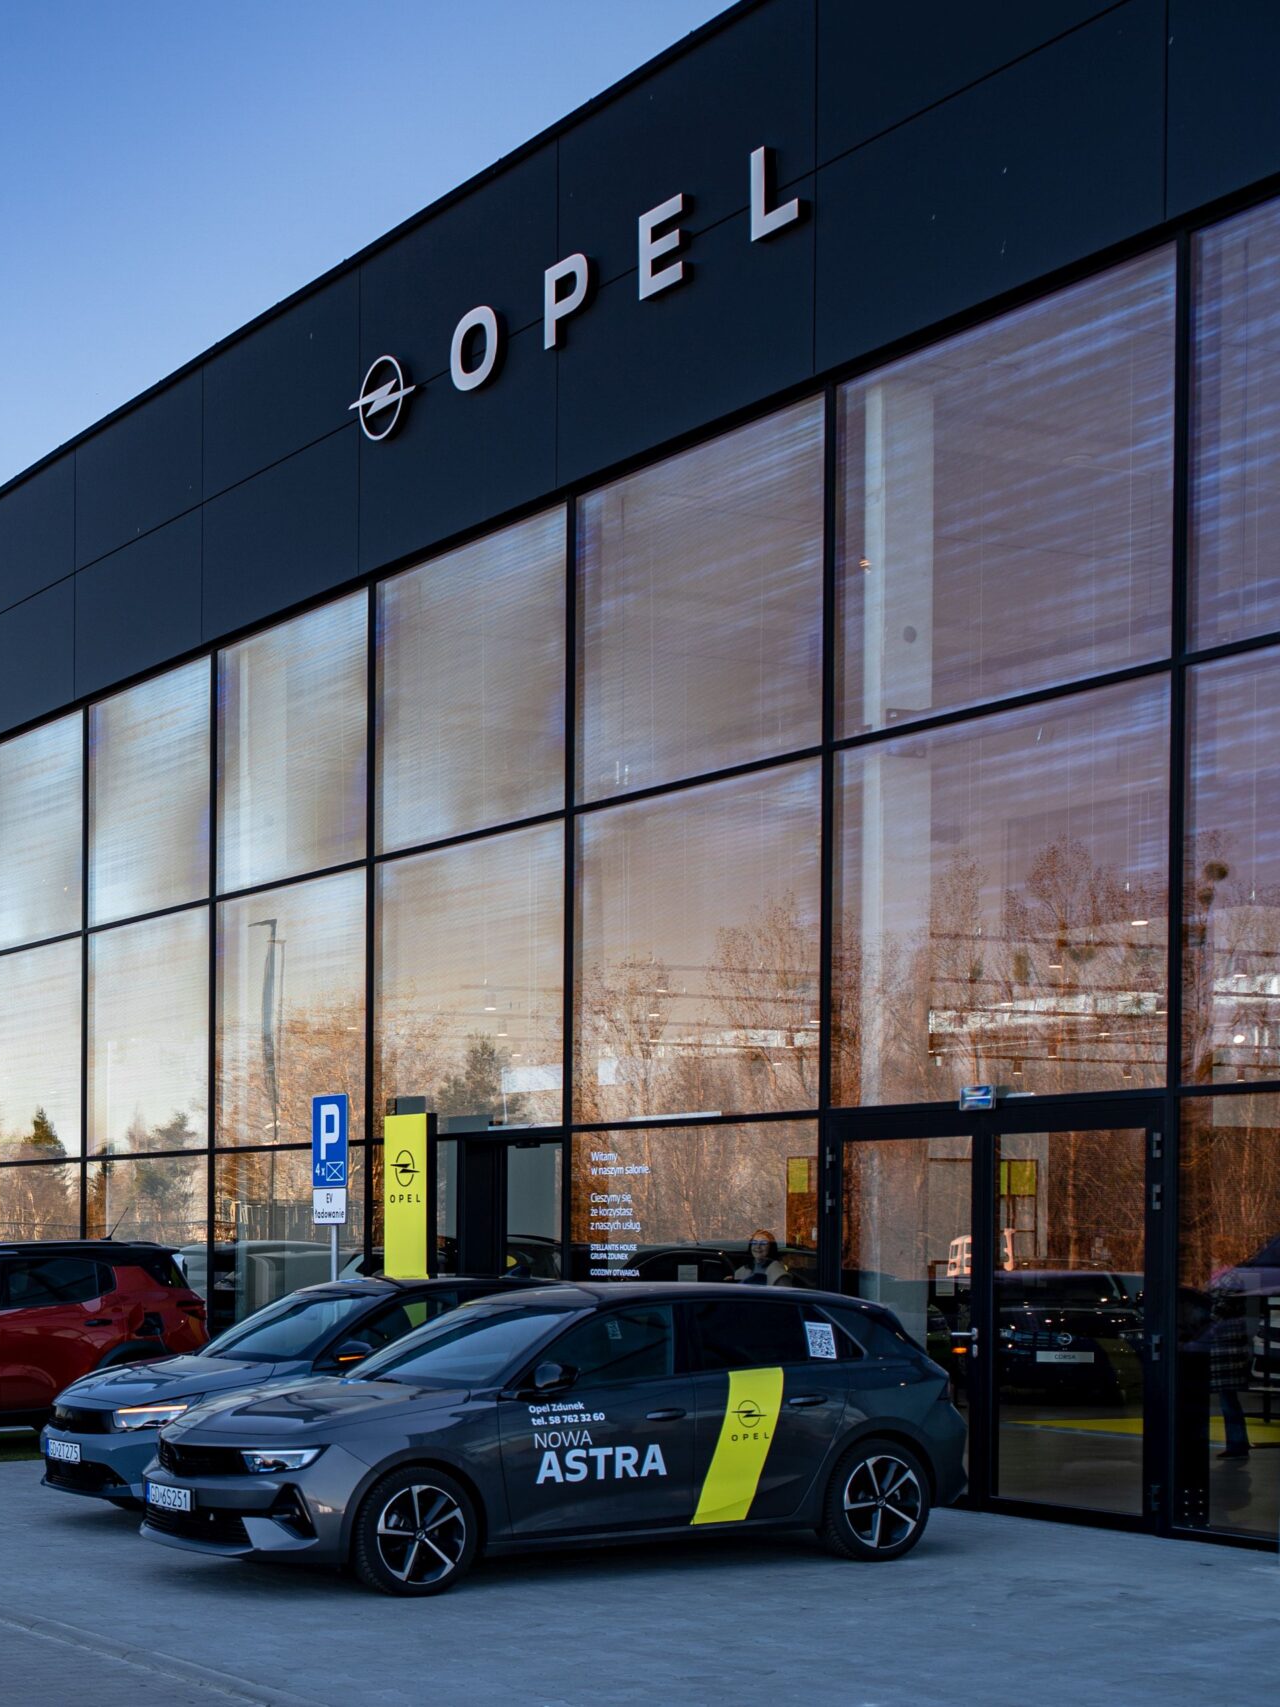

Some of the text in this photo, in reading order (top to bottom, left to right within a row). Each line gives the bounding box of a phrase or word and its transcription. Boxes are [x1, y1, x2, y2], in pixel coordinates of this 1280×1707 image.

[450, 146, 799, 391] OPEL
[320, 1103, 340, 1160] P
[591, 1152, 617, 1163] Witamy
[326, 1192, 334, 1204] EV
[389, 1194, 421, 1204] OPEL
[528, 1401, 585, 1414] Opel Zdunek
[531, 1411, 606, 1426] tel. 58 762 32 60
[534, 1429, 593, 1448] NOWA
[731, 1431, 770, 1442] OPEL
[536, 1443, 668, 1485] ASTRA
